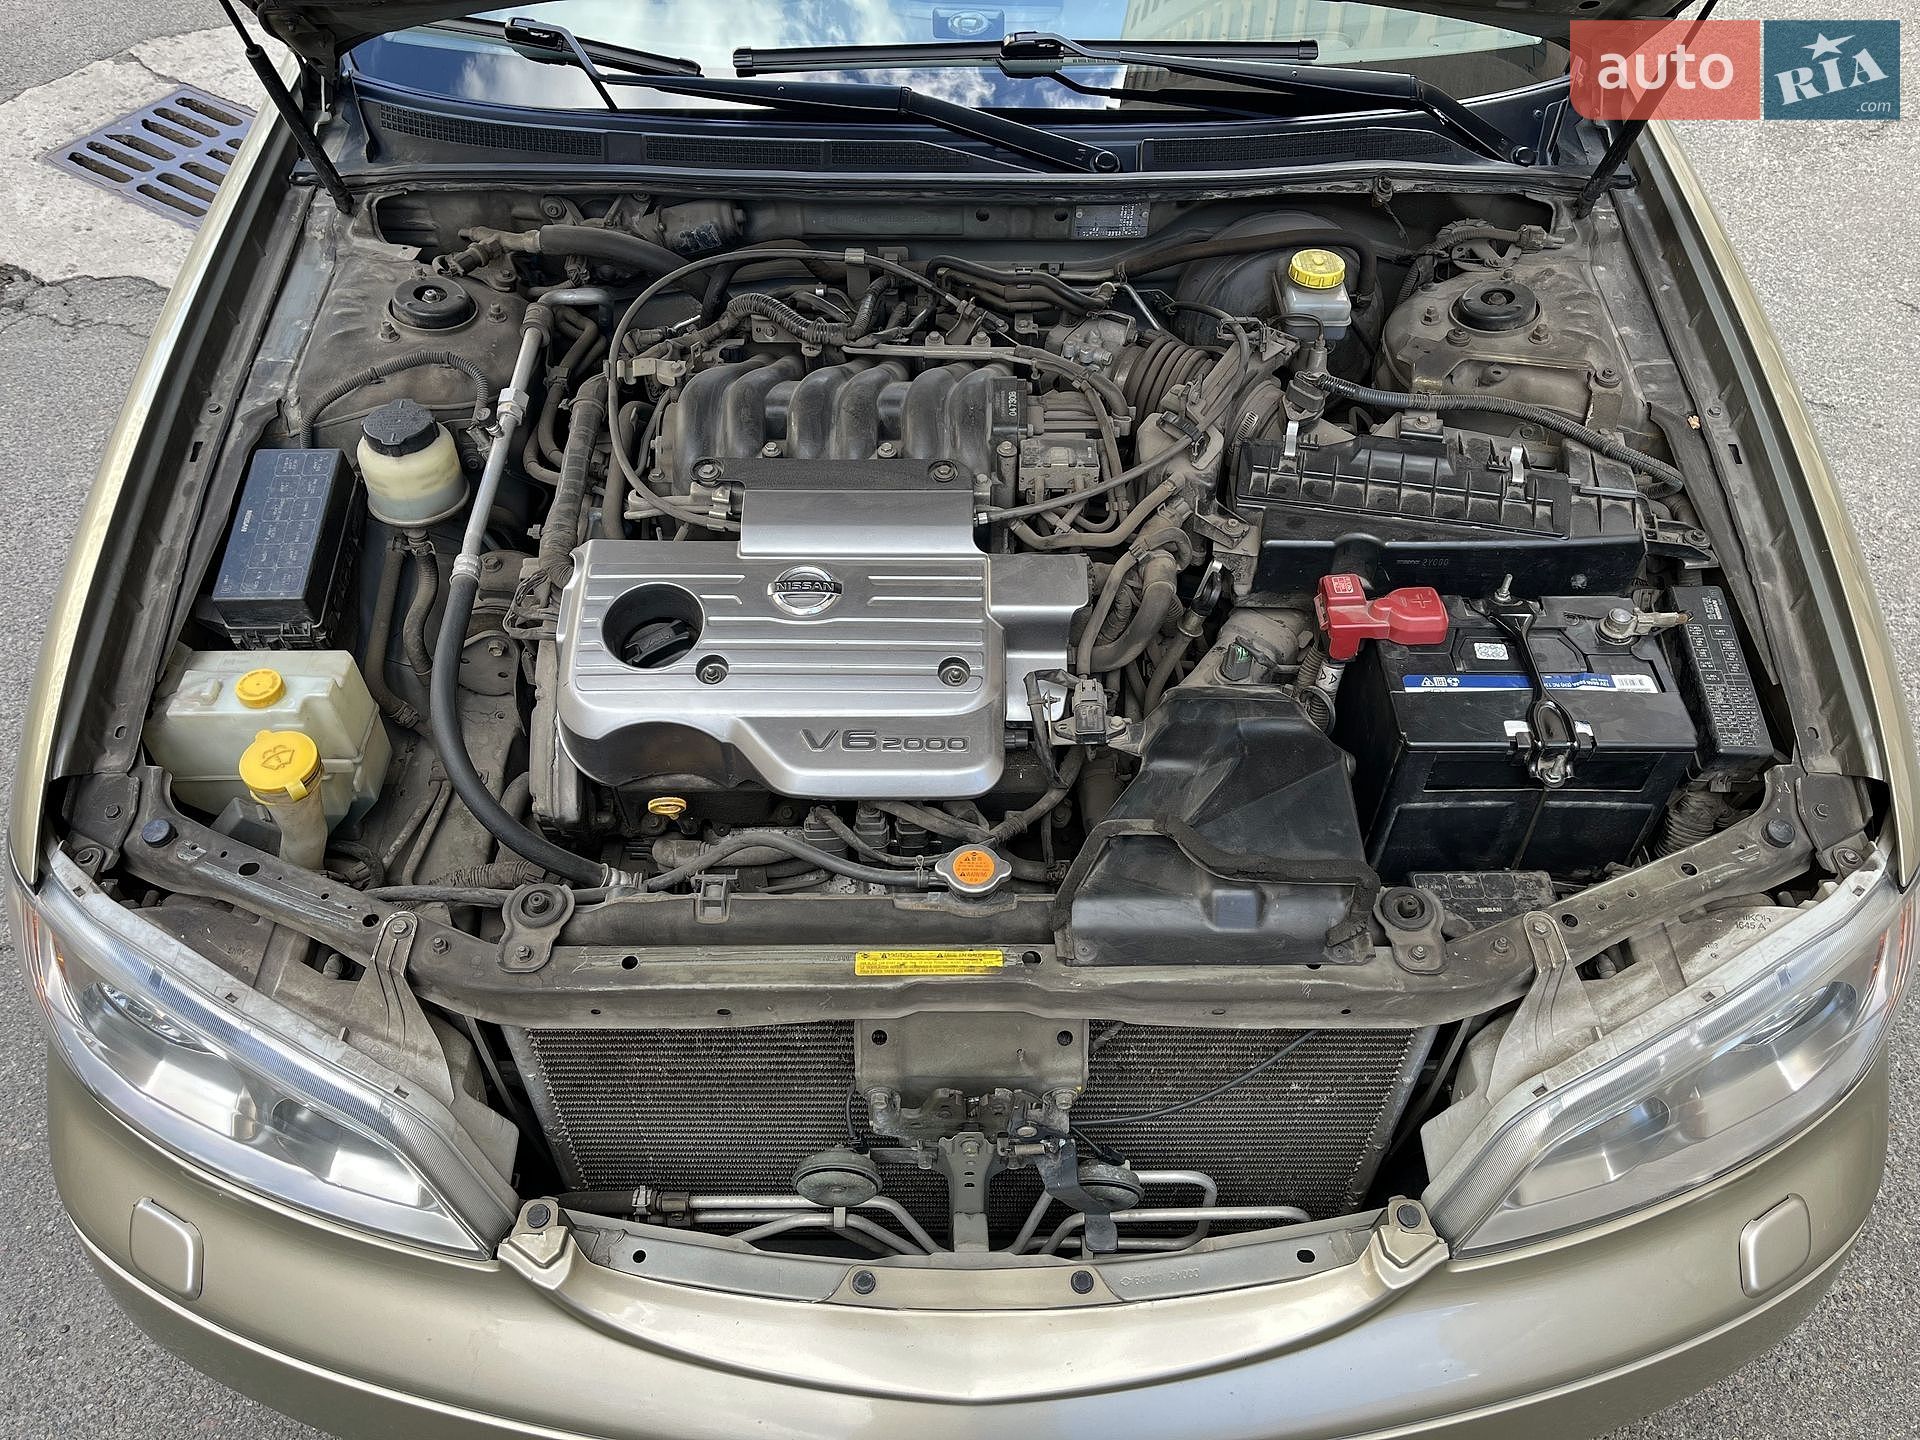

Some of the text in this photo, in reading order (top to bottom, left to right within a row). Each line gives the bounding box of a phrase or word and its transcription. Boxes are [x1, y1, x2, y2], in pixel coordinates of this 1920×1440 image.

[776, 581, 835, 591] NISSAN
[800, 728, 970, 753] V6 2000
